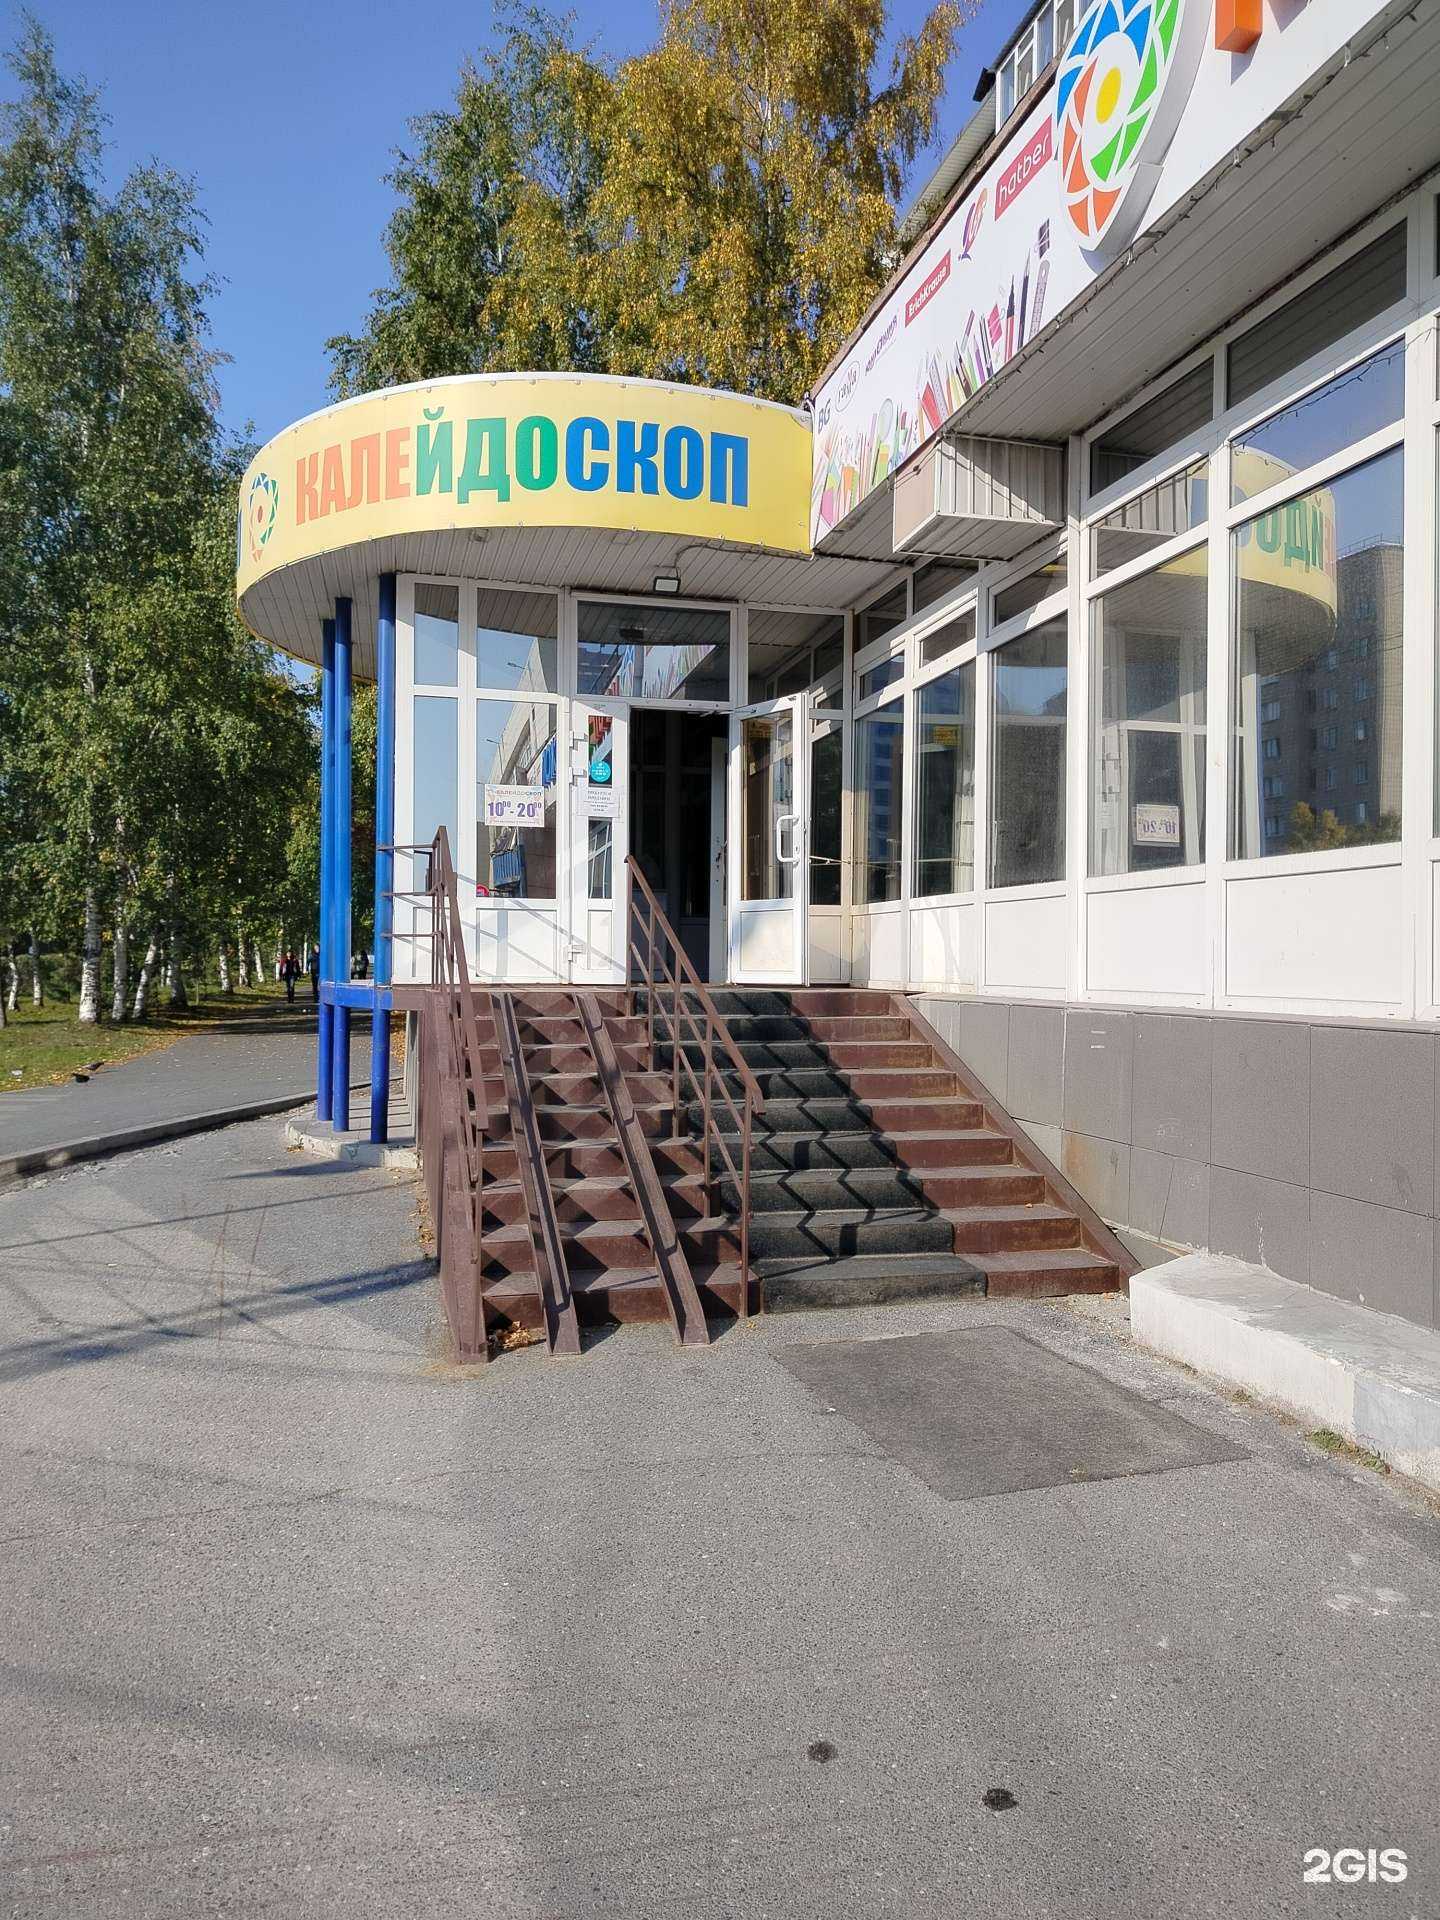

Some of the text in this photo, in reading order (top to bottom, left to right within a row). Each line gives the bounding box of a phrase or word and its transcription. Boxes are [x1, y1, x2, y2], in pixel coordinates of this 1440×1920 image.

[998, 132, 1050, 208] hatber
[908, 265, 947, 317] ErichKrause
[818, 398, 831, 434] BG
[296, 406, 749, 526] КАЛЕЙДОСКОП
